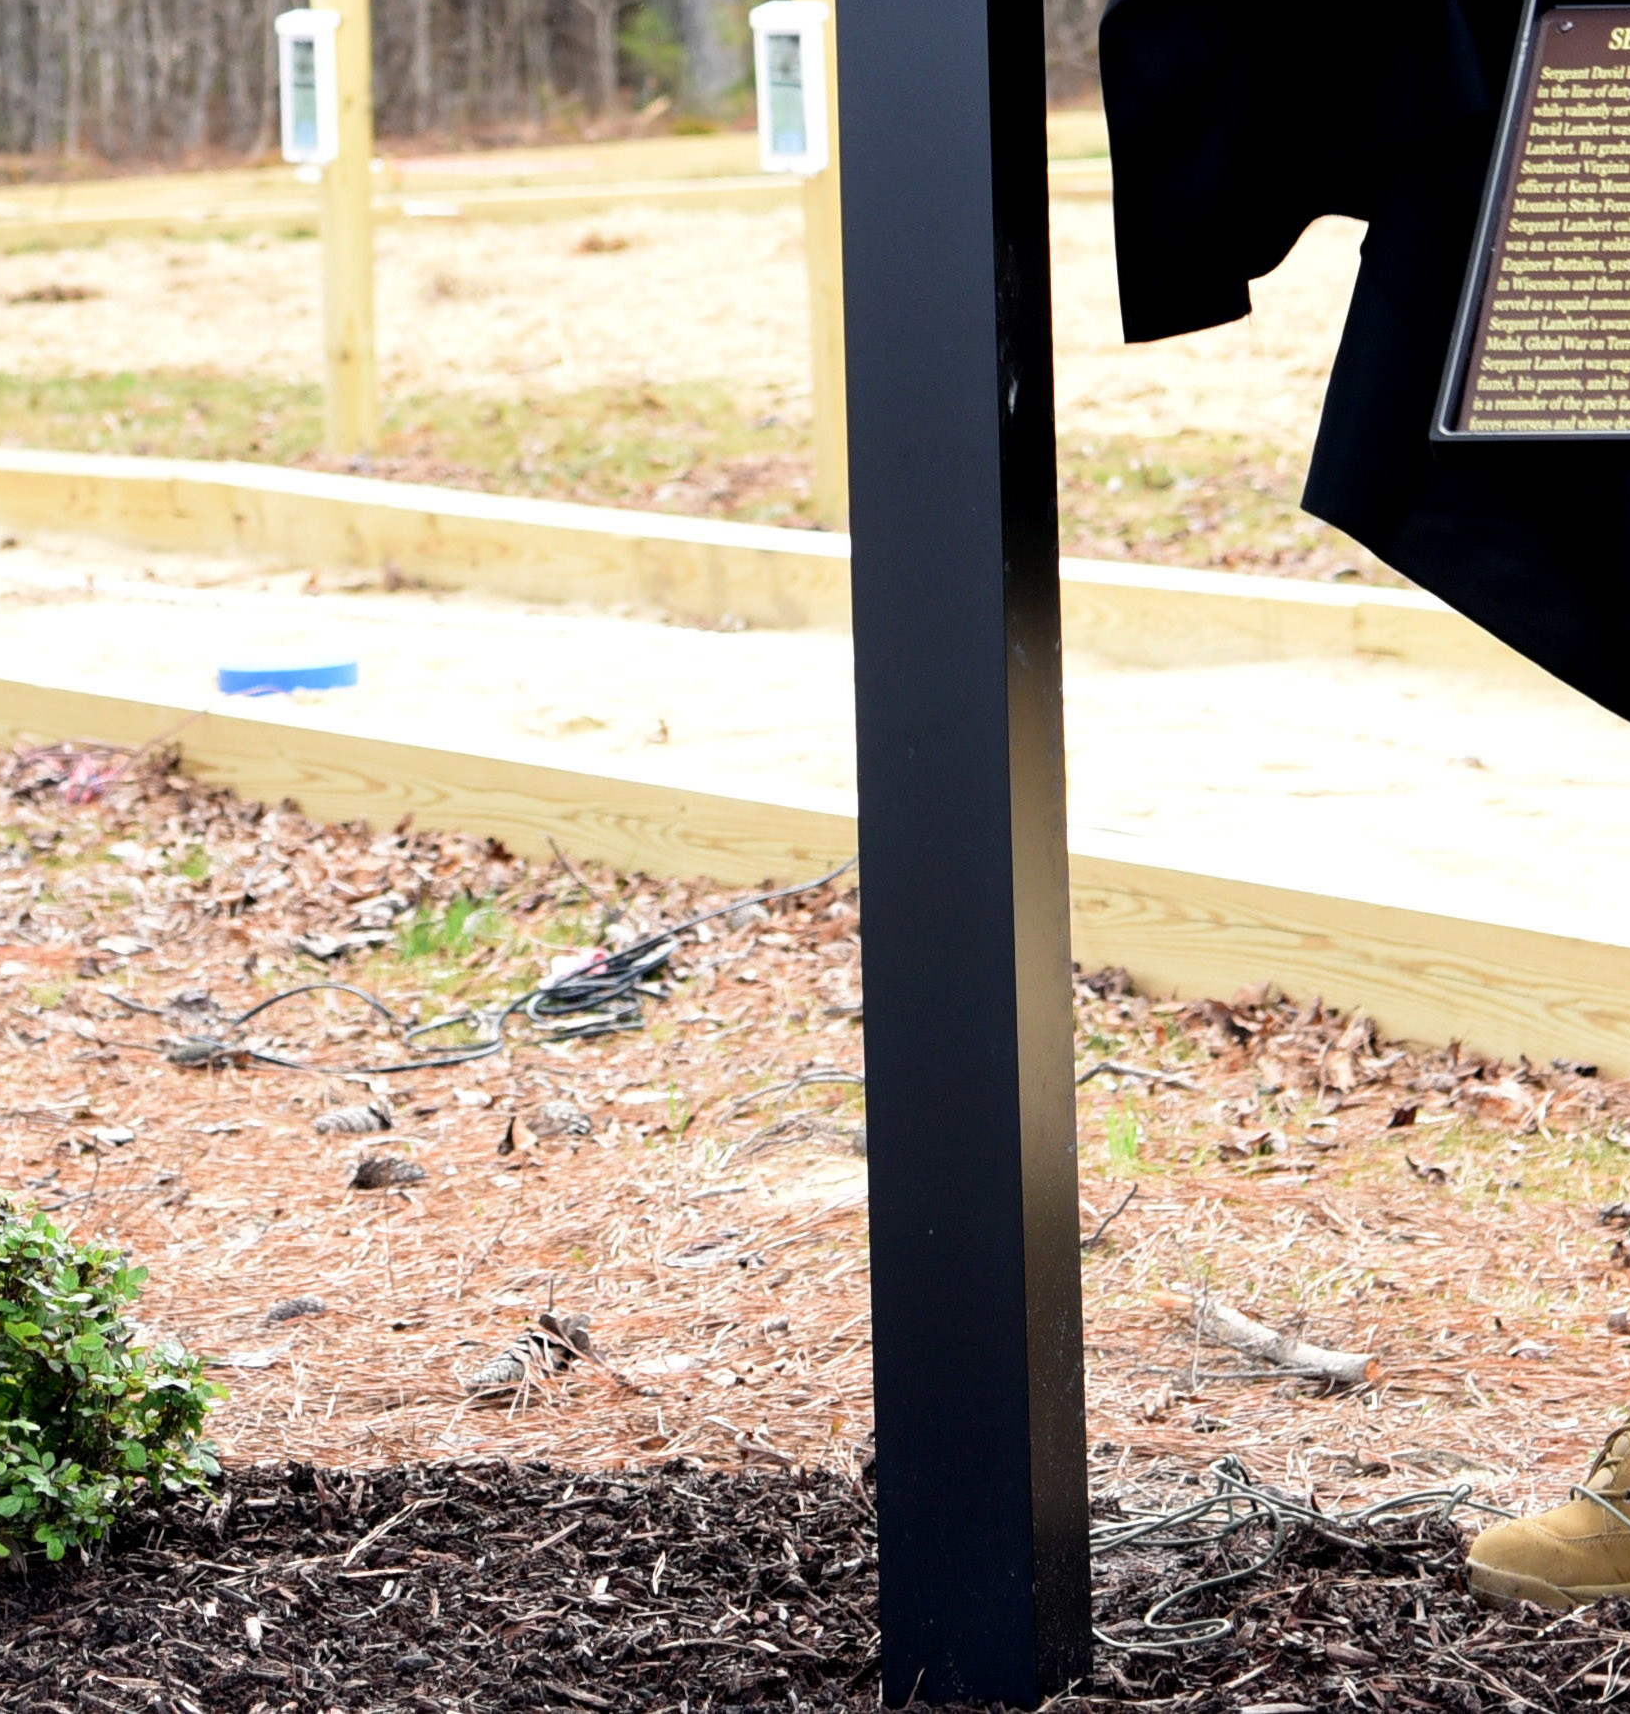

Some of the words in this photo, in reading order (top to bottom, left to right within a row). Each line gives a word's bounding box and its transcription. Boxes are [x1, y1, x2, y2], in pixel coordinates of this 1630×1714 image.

[1541, 65, 1589, 83] Sergeant
[1591, 65, 1624, 78] David
[1533, 103, 1562, 116] while
[1564, 103, 1610, 120] valiantly
[1521, 160, 1581, 173] Southwest
[1583, 159, 1629, 177] Virginia
[1509, 218, 1560, 236] Sergeant
[1561, 218, 1611, 231] Lambert
[1493, 296, 1529, 310] served
[1531, 300, 1543, 309] as
[1554, 296, 1588, 314] squad
[1524, 337, 1562, 350] Global
[1563, 337, 1587, 350] War
[1589, 340, 1605, 350] on
